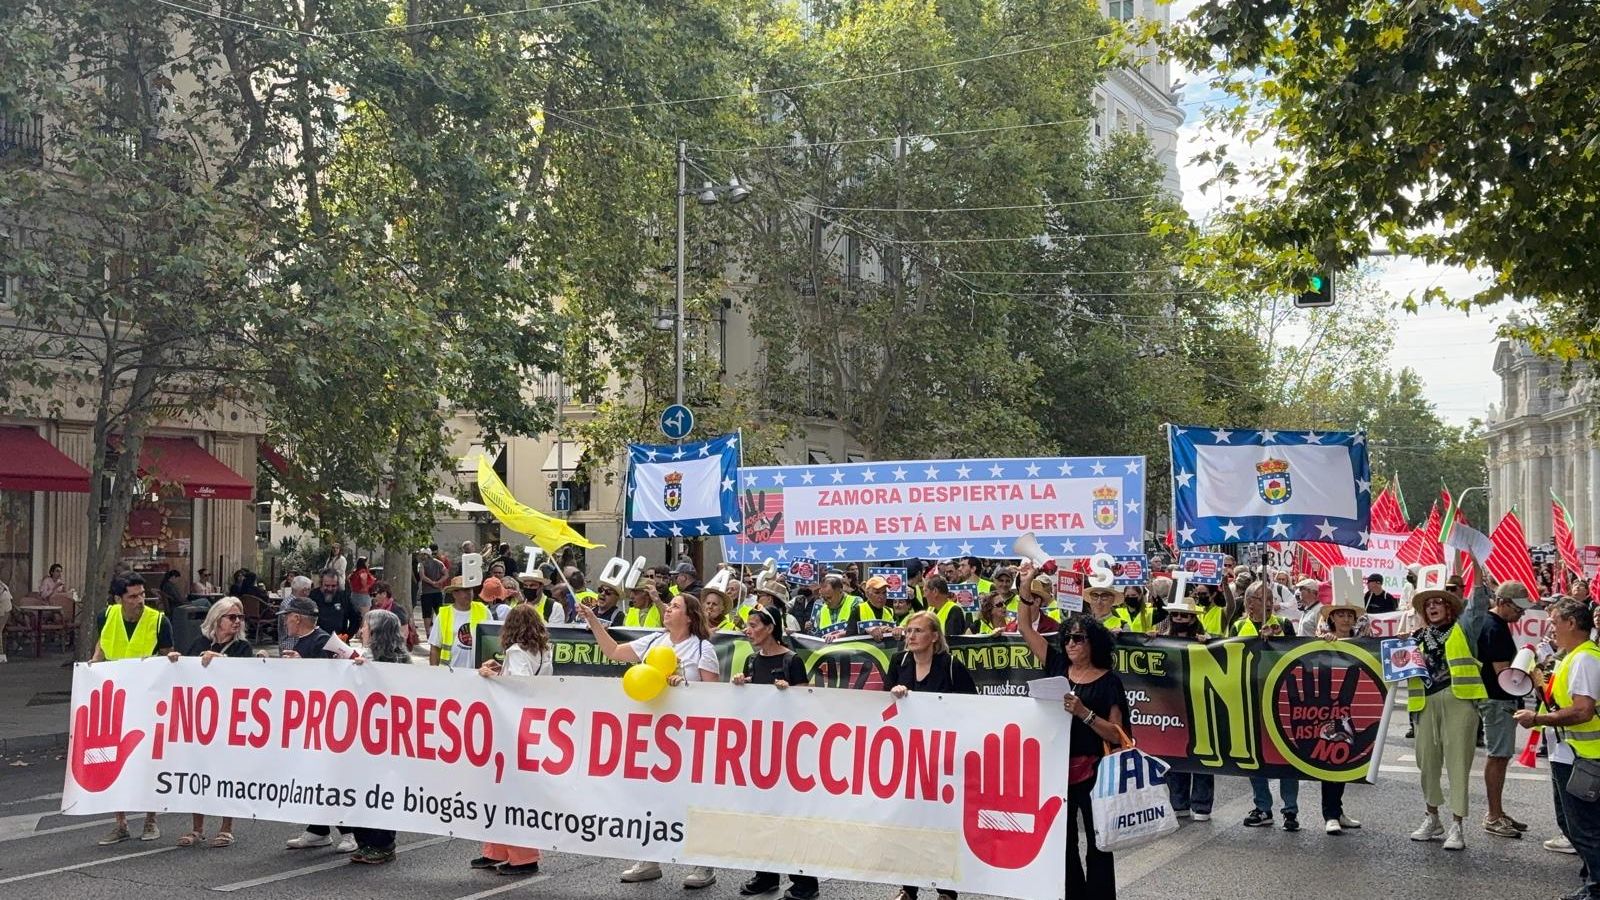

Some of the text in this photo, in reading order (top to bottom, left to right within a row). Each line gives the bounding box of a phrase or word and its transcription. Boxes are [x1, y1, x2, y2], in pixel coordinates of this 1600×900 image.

[818, 483, 1057, 507] ZAMORA DESPIERTA LA
[795, 512, 1084, 536] MIERDA ESTÁ EN LA PUERTA
[1378, 540, 1390, 550] LA
[1344, 557, 1395, 570] NUESTRO
[1371, 619, 1400, 638] ST
[983, 680, 1151, 706] nuestra ga.
[1129, 708, 1185, 732] Europa.
[1292, 700, 1351, 721] BIOGÁS
[151, 686, 957, 804] ¡NO ES PROGRESO, ES DESTRUCCIÓN!
[1310, 738, 1350, 765] NO
[156, 771, 685, 848] STOP macroplantas de biogás y macrogranjas
[1117, 805, 1165, 830] ACTION
